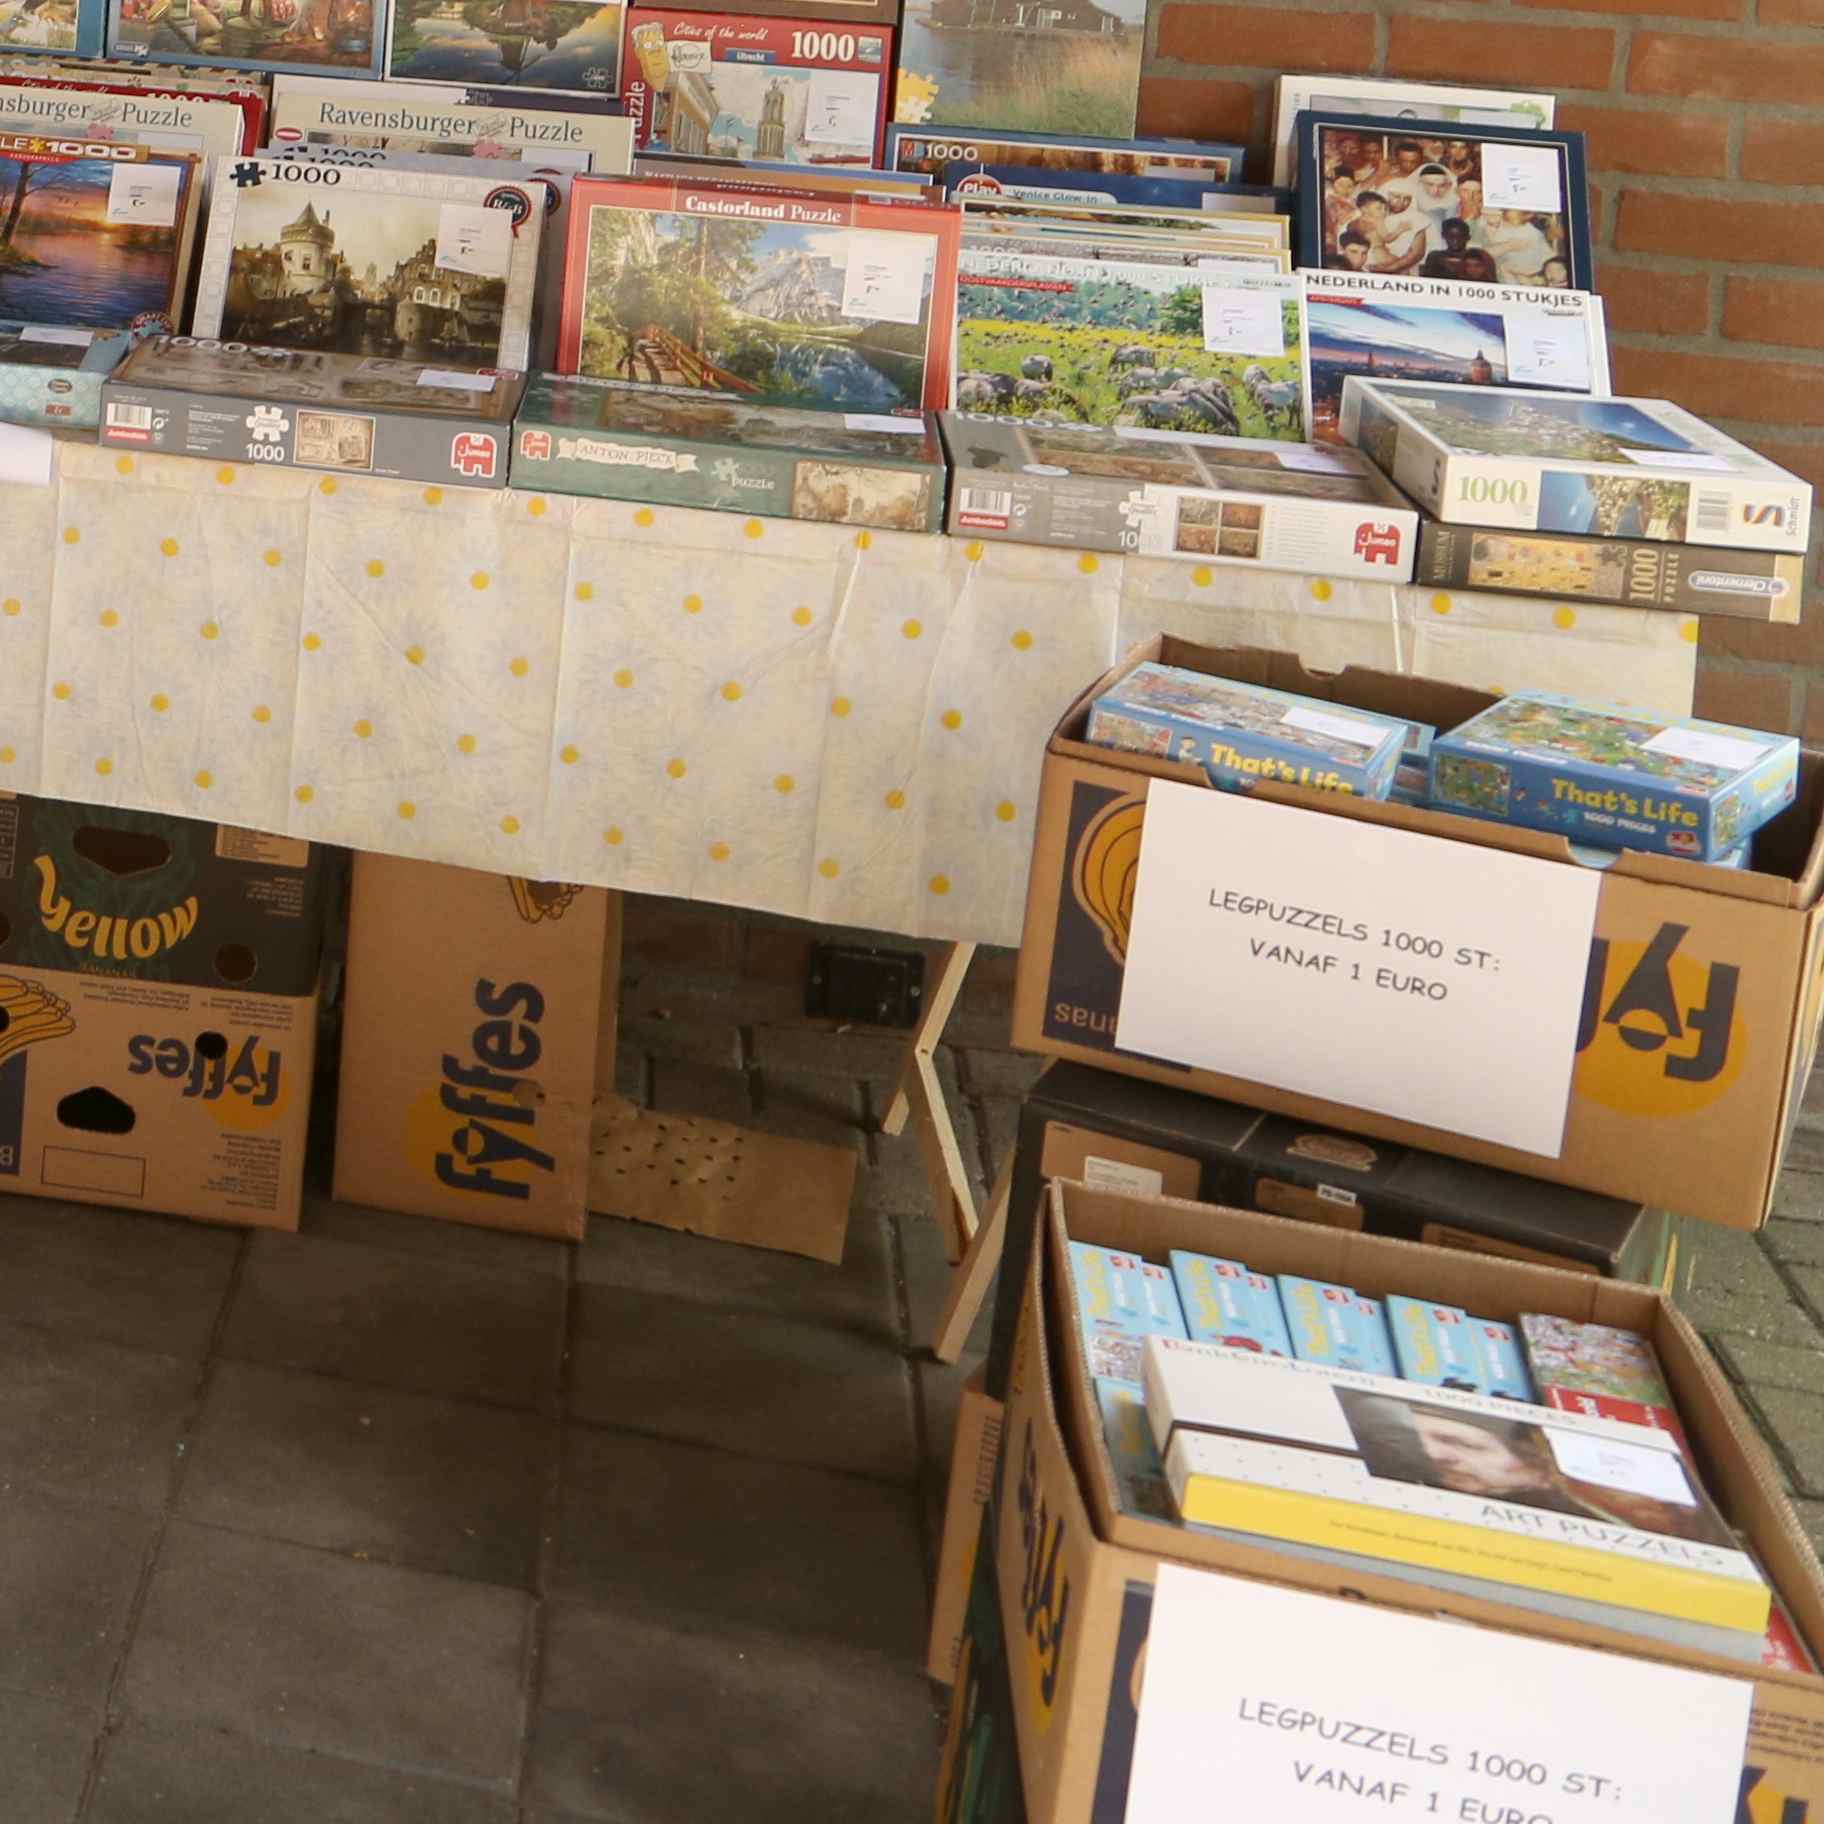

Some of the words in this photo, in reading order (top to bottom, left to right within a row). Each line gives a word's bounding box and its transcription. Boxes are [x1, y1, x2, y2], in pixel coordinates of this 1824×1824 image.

[792, 31, 854, 62] 1000
[121, 102, 193, 127] Puzzle
[319, 102, 478, 137] Ravensburger
[509, 116, 584, 142] Puzzle
[46, 141, 137, 159] 1000
[926, 143, 978, 162] 1000
[271, 163, 341, 186] 1000
[685, 195, 784, 219] Castorland
[790, 204, 842, 224] Puzzle
[1306, 275, 1424, 294] NEDERLAND
[1430, 286, 1451, 296] IN
[1456, 287, 1495, 300] 1000
[1501, 290, 1583, 307] STUKJES
[245, 443, 285, 463] 1000
[579, 444, 630, 462] ANTON
[1457, 476, 1528, 504] 1000
[1629, 548, 1659, 601] 1000
[1695, 574, 1769, 593] Clementoni
[1210, 744, 1297, 786] That's
[1302, 765, 1355, 795] Life
[1551, 777, 1639, 817] That's
[1642, 795, 1699, 828] Life
[1208, 887, 1369, 942] LEGPUZZELS
[1382, 928, 1444, 959] 1000
[1454, 947, 1502, 973] ST:
[1249, 938, 1338, 974] VANAF
[1350, 961, 1362, 981] 1
[1375, 967, 1448, 1001] EURO
[1480, 1504, 1545, 1529] ART
[1559, 1518, 1724, 1566] PUZZELS
[1238, 1696, 1451, 1767] LEGPUZZELS
[1468, 1749, 1549, 1787] 1000
[1562, 1771, 1623, 1803] ST:
[1292, 1760, 1411, 1806] VANAF
[1425, 1791, 1442, 1816] 1
